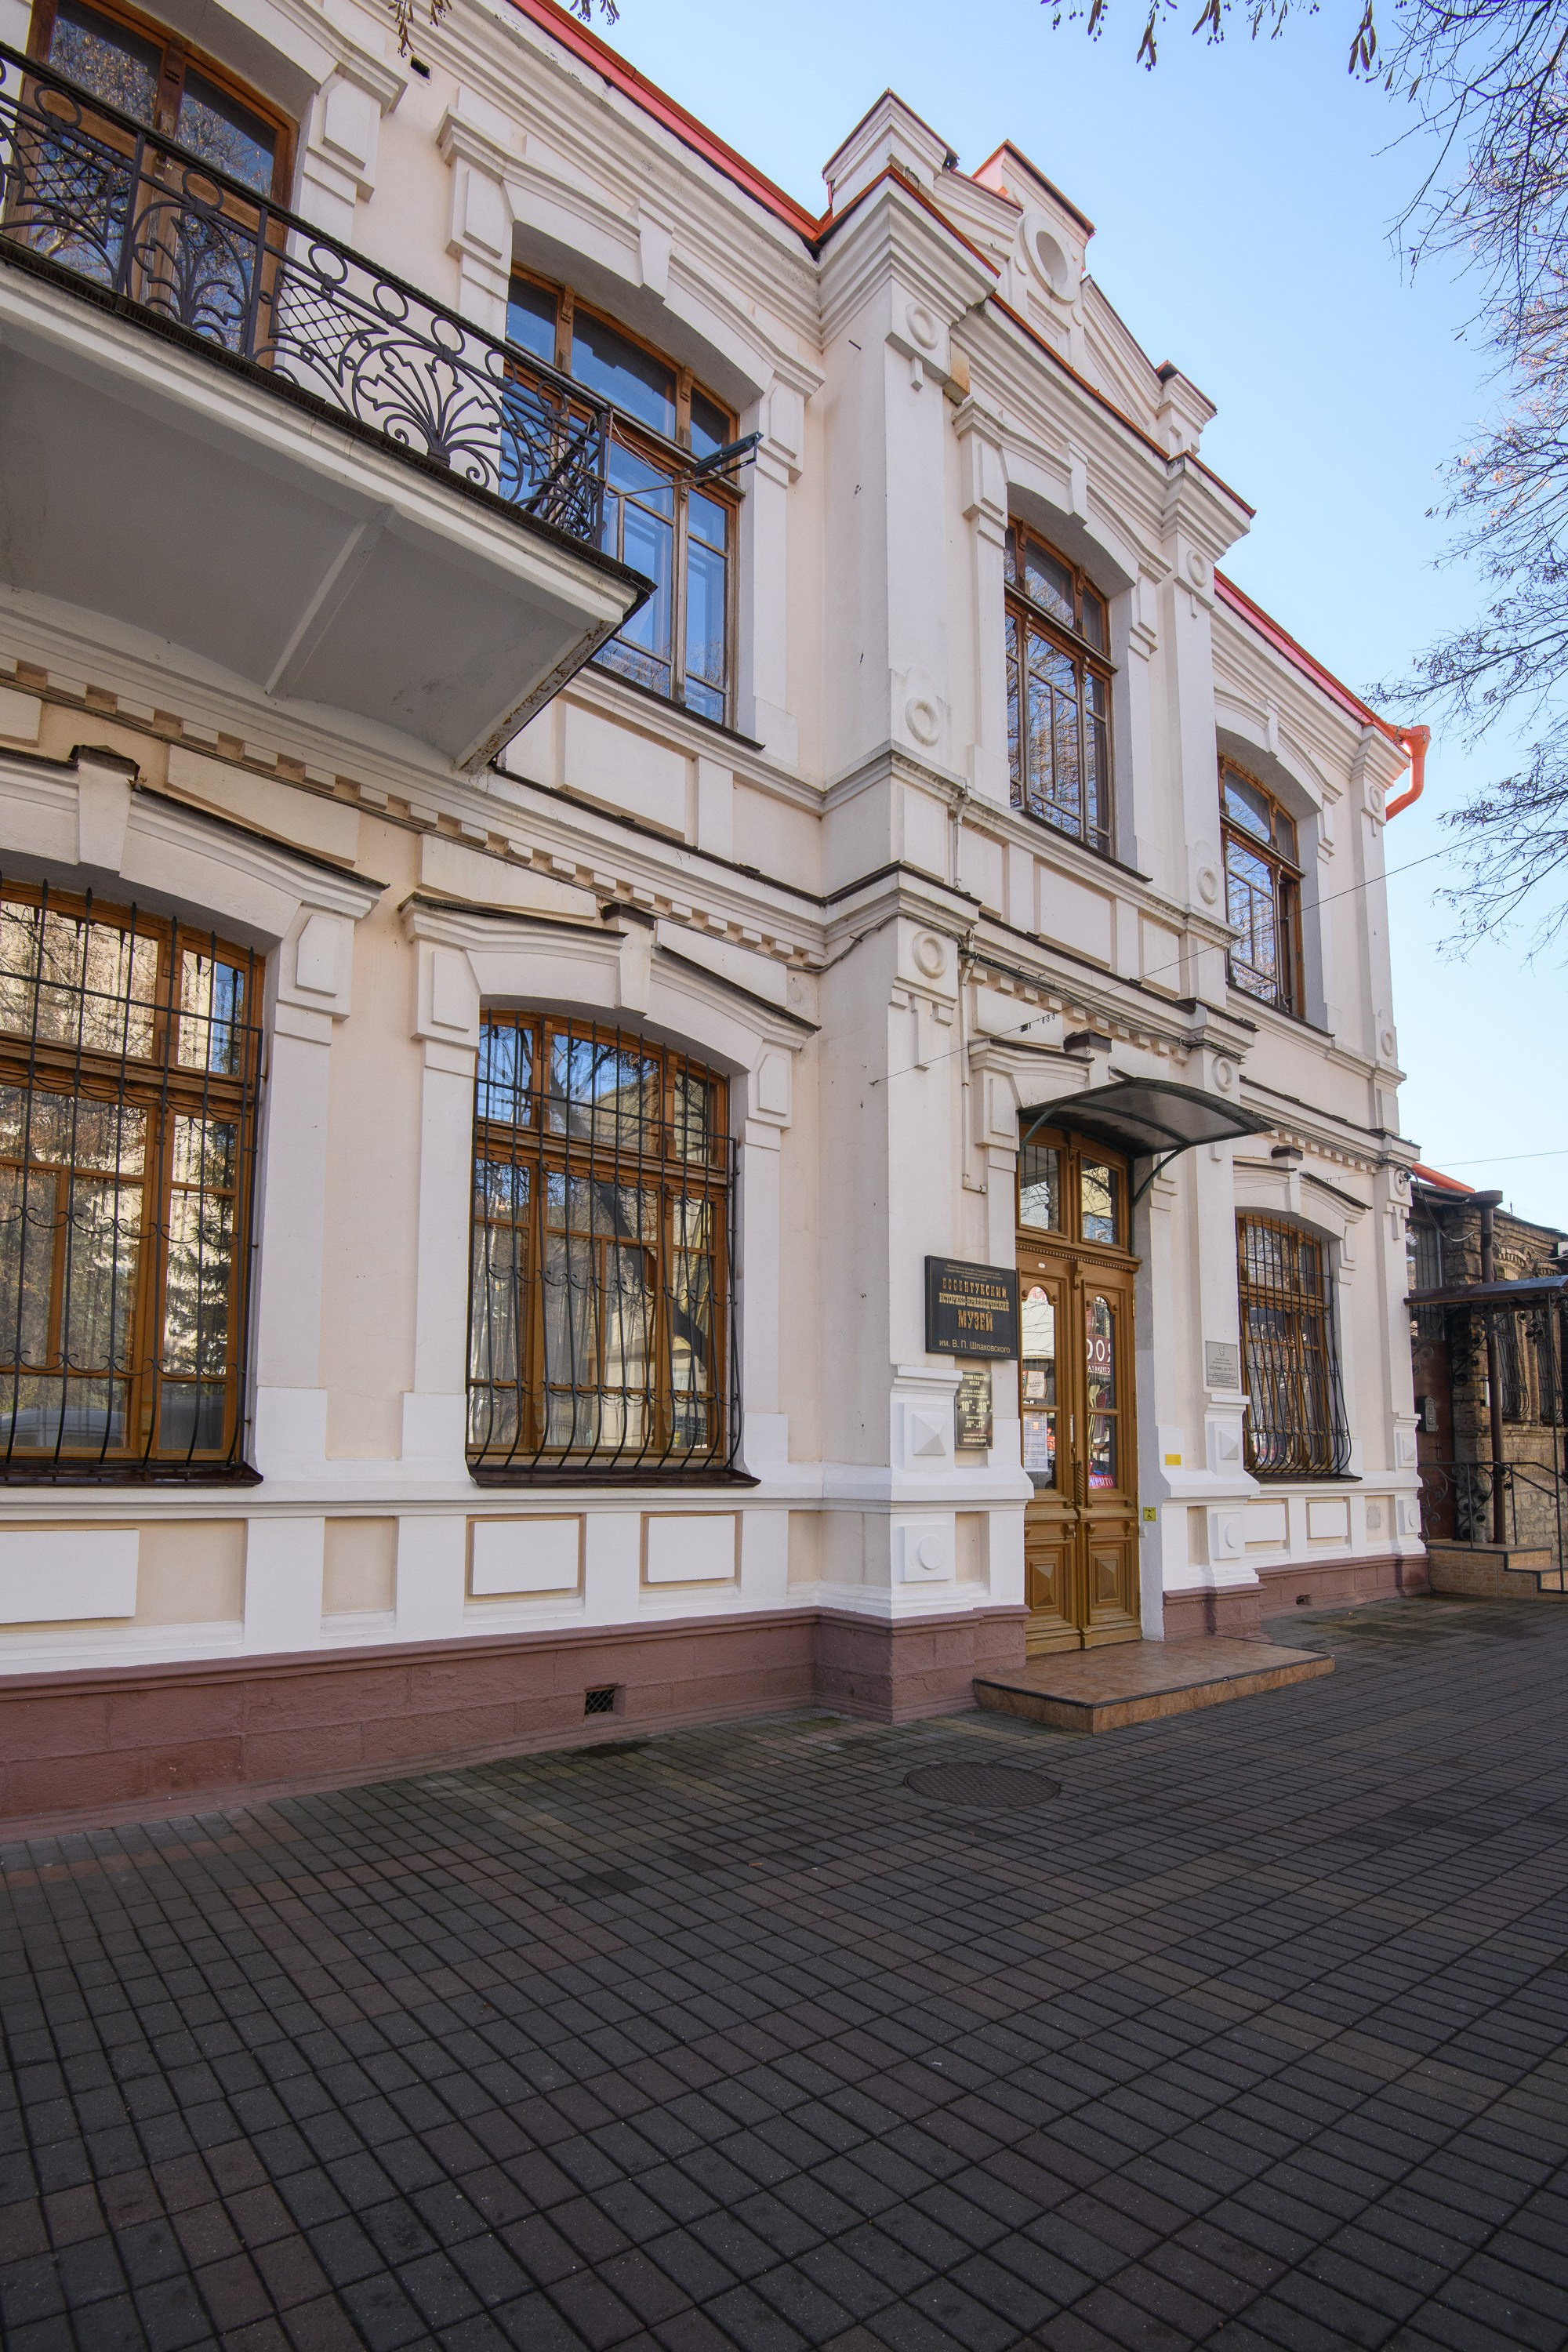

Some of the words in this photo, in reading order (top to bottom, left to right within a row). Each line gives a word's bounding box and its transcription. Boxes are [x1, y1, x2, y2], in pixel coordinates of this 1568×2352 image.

[942, 1278, 1007, 1298] ЕССЕНТУКСКИЙ
[939, 1292, 1009, 1312] ИСТОРИКО-КРАЕВЕДЧЕСКИЙ
[958, 1309, 993, 1332] МУЗЕЙ
[953, 1339, 959, 1348] В.
[961, 1340, 968, 1348] П.
[970, 1341, 1011, 1353] Шпаковского
